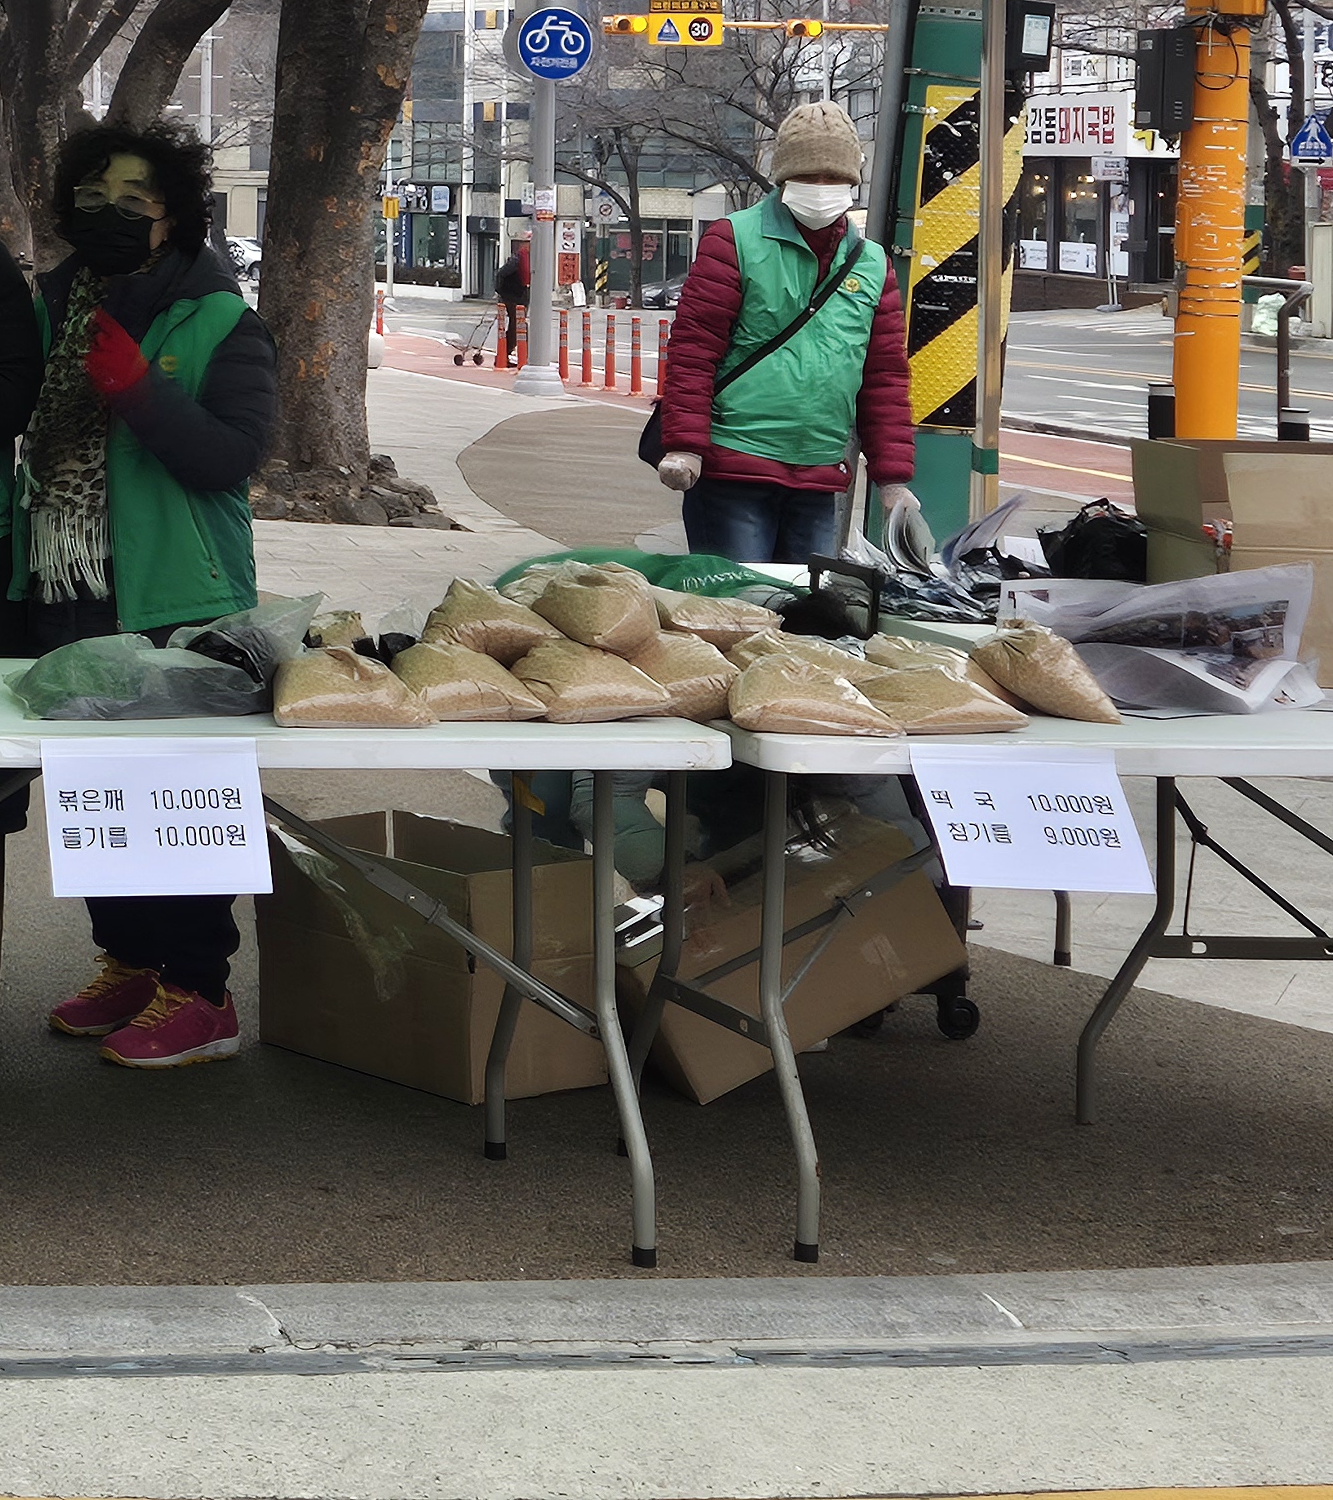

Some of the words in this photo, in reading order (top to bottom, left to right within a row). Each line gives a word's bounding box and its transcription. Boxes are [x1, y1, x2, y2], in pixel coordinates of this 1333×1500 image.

[691, 22, 709, 37] 30
[58, 789, 125, 813] 볶은깨
[61, 826, 128, 850] 들기름
[946, 822, 1013, 844] 참기름
